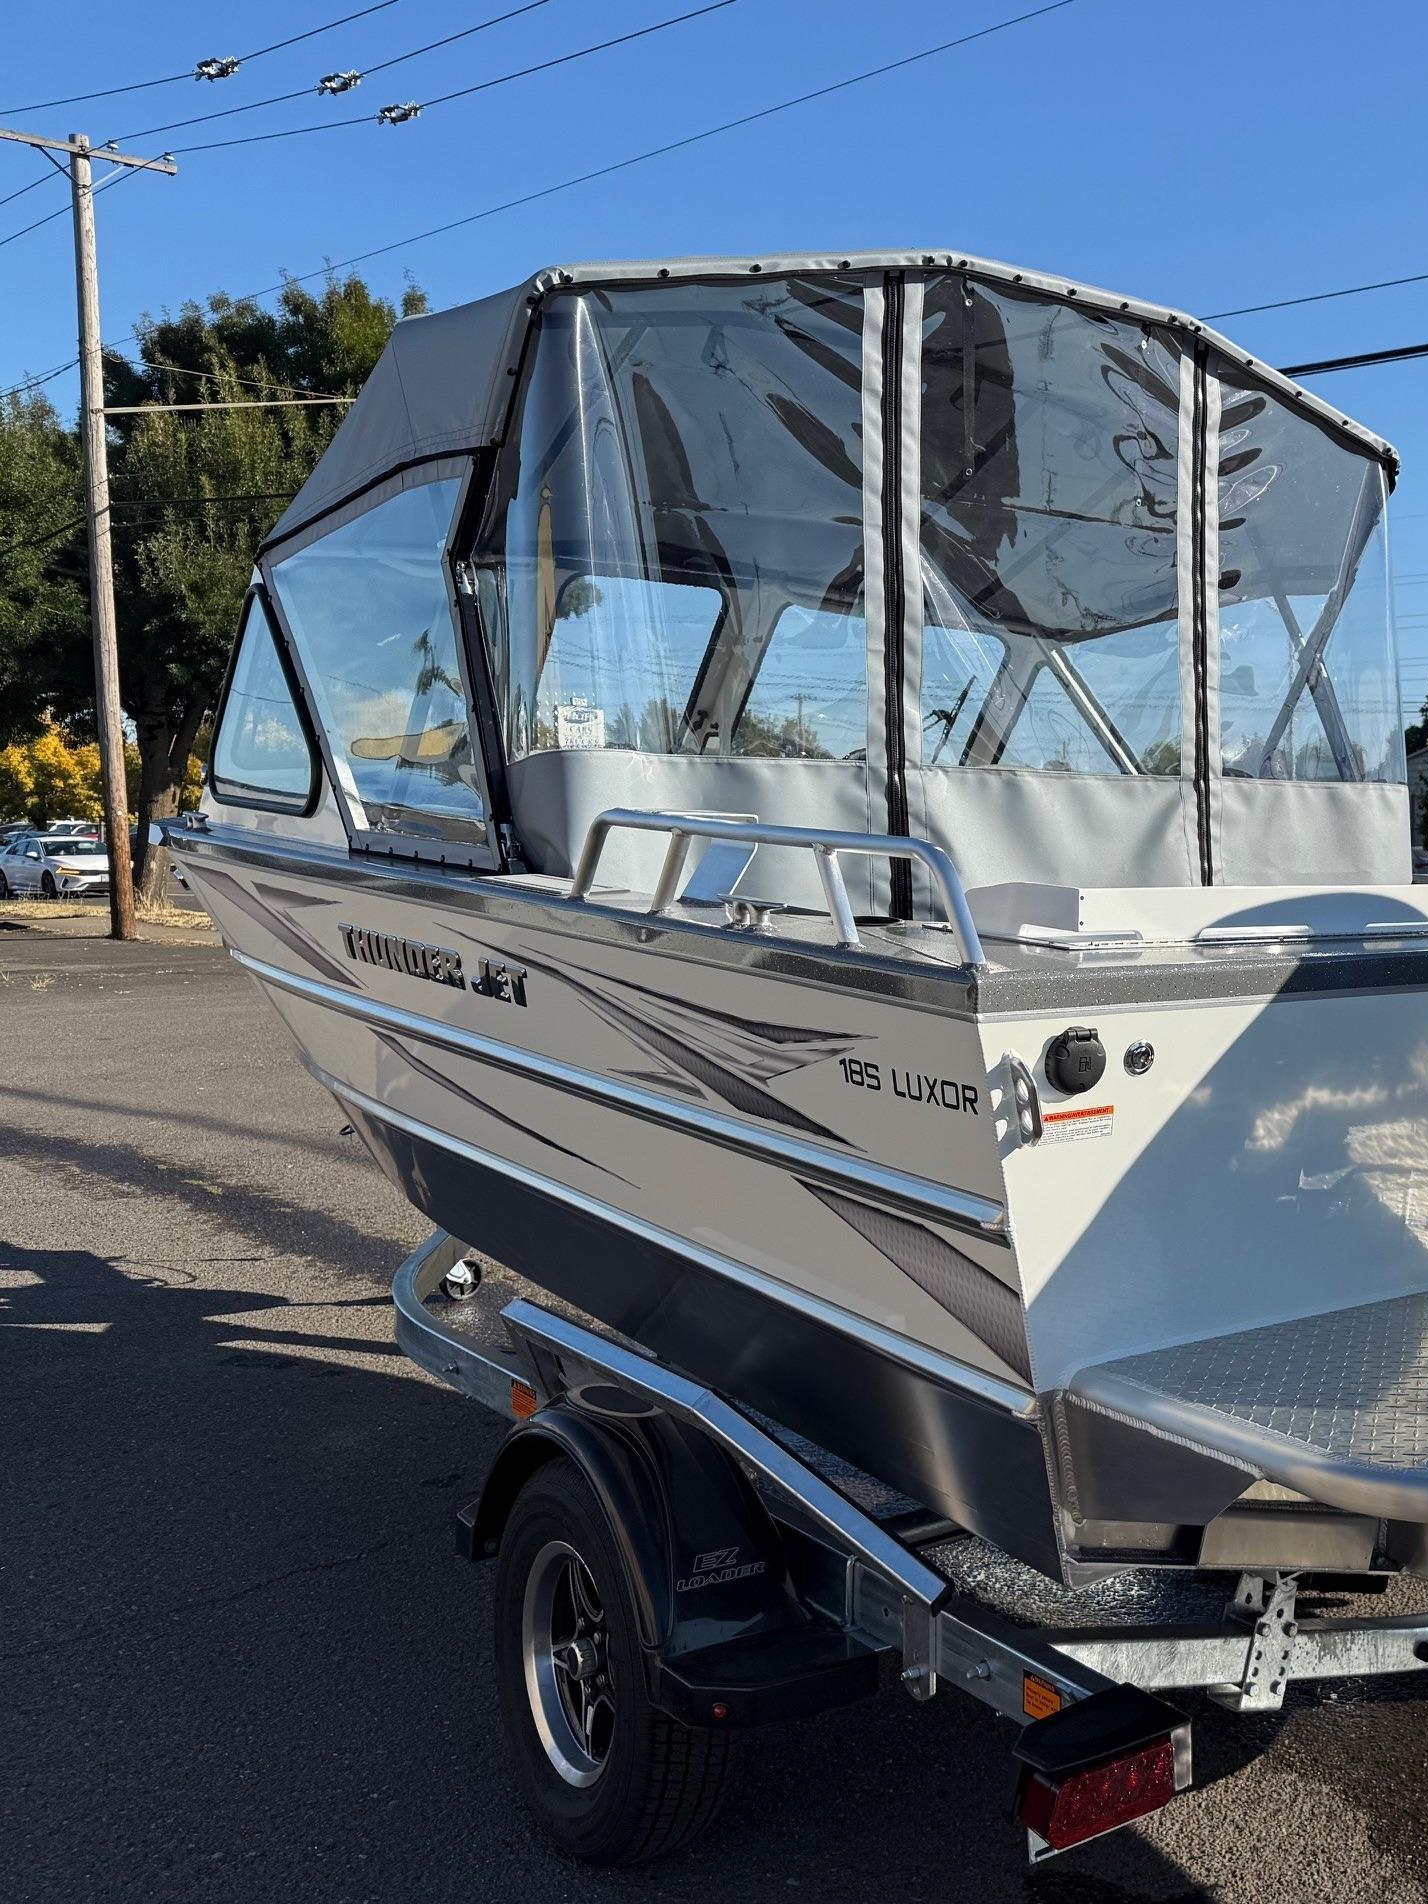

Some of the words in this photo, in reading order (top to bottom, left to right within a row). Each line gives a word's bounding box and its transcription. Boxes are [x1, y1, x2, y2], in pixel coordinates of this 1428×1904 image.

[337, 922, 466, 991] THUNDER
[471, 957, 528, 1007] JET
[839, 1058, 881, 1092] 185
[892, 1069, 979, 1115] LUXOR
[677, 1561, 766, 1592] LOADER
[693, 1547, 739, 1573] EZ
